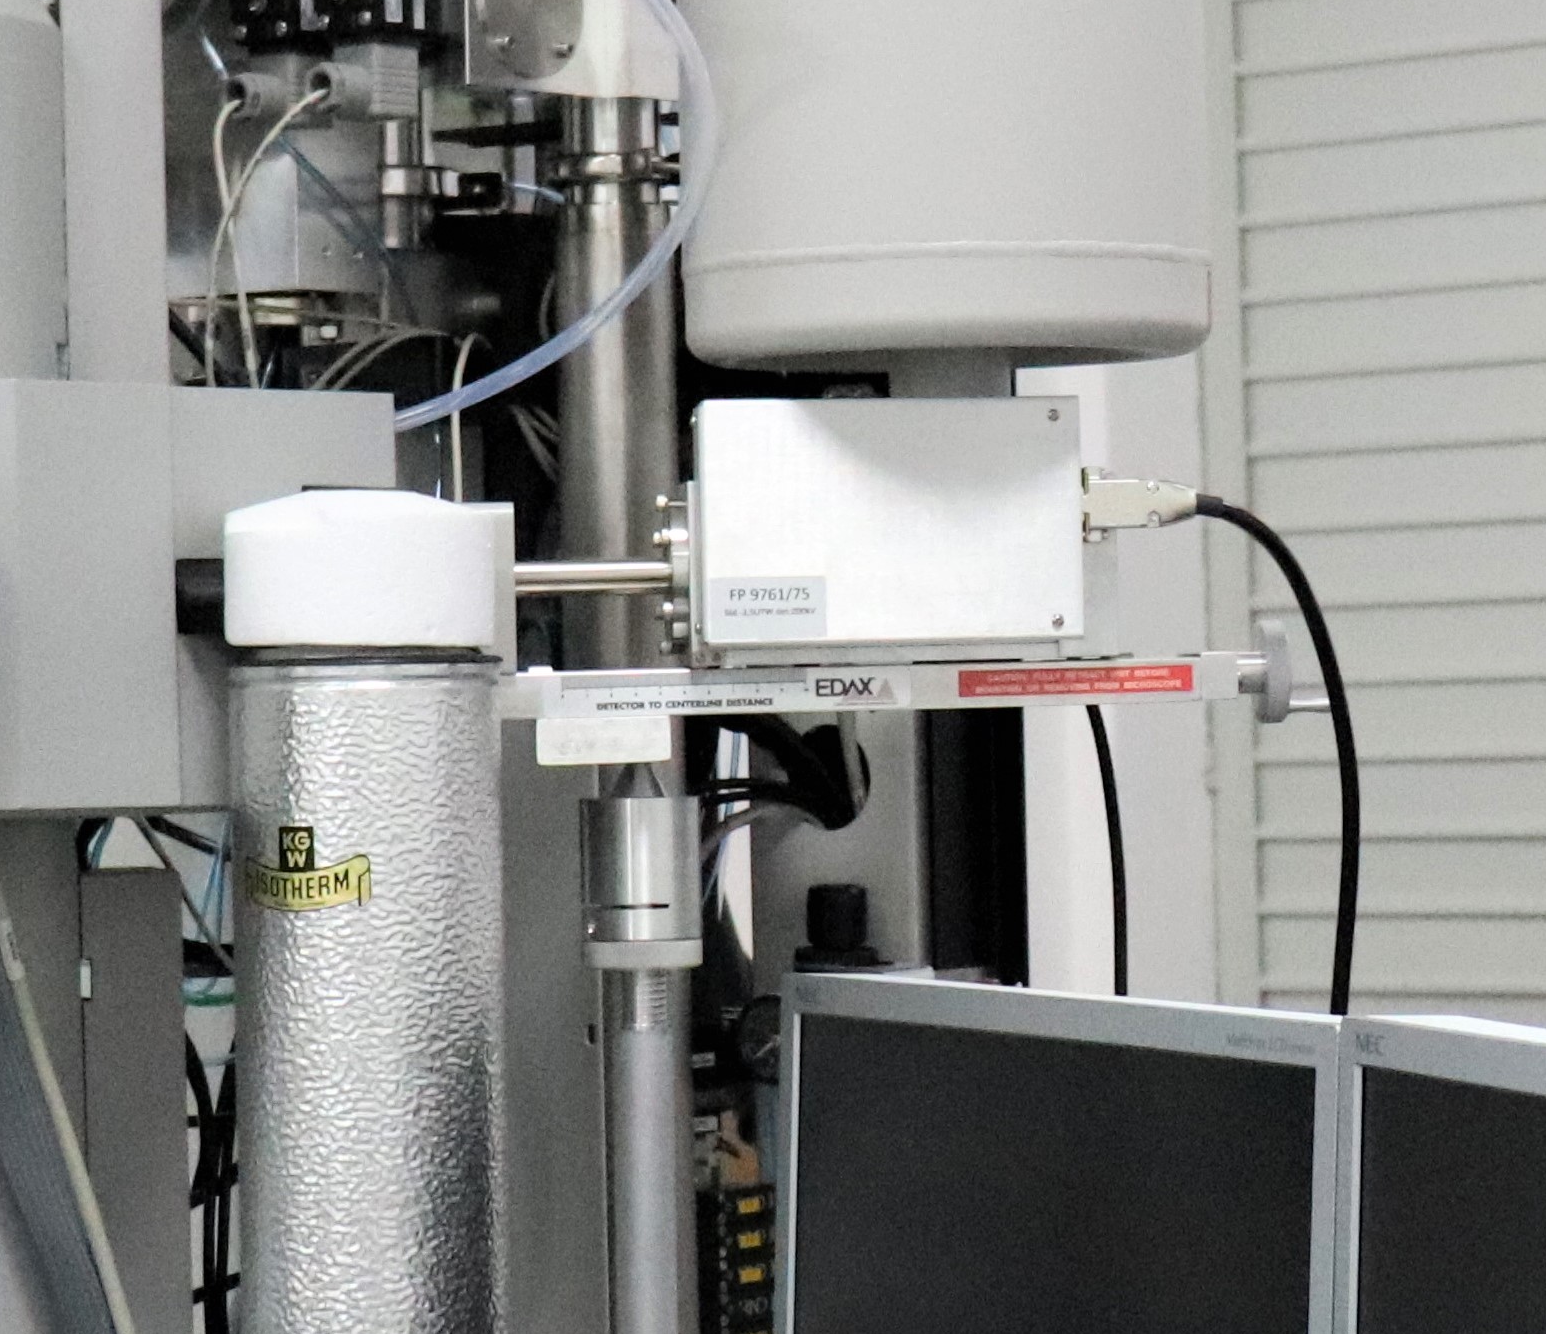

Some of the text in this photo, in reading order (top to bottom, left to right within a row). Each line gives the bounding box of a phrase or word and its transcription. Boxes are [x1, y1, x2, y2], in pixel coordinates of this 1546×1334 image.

[729, 587, 811, 601] FP 9761/75
[815, 677, 875, 697] EDAX
[597, 697, 774, 711] DETECTOR TO CENTERLINE DISTANCE
